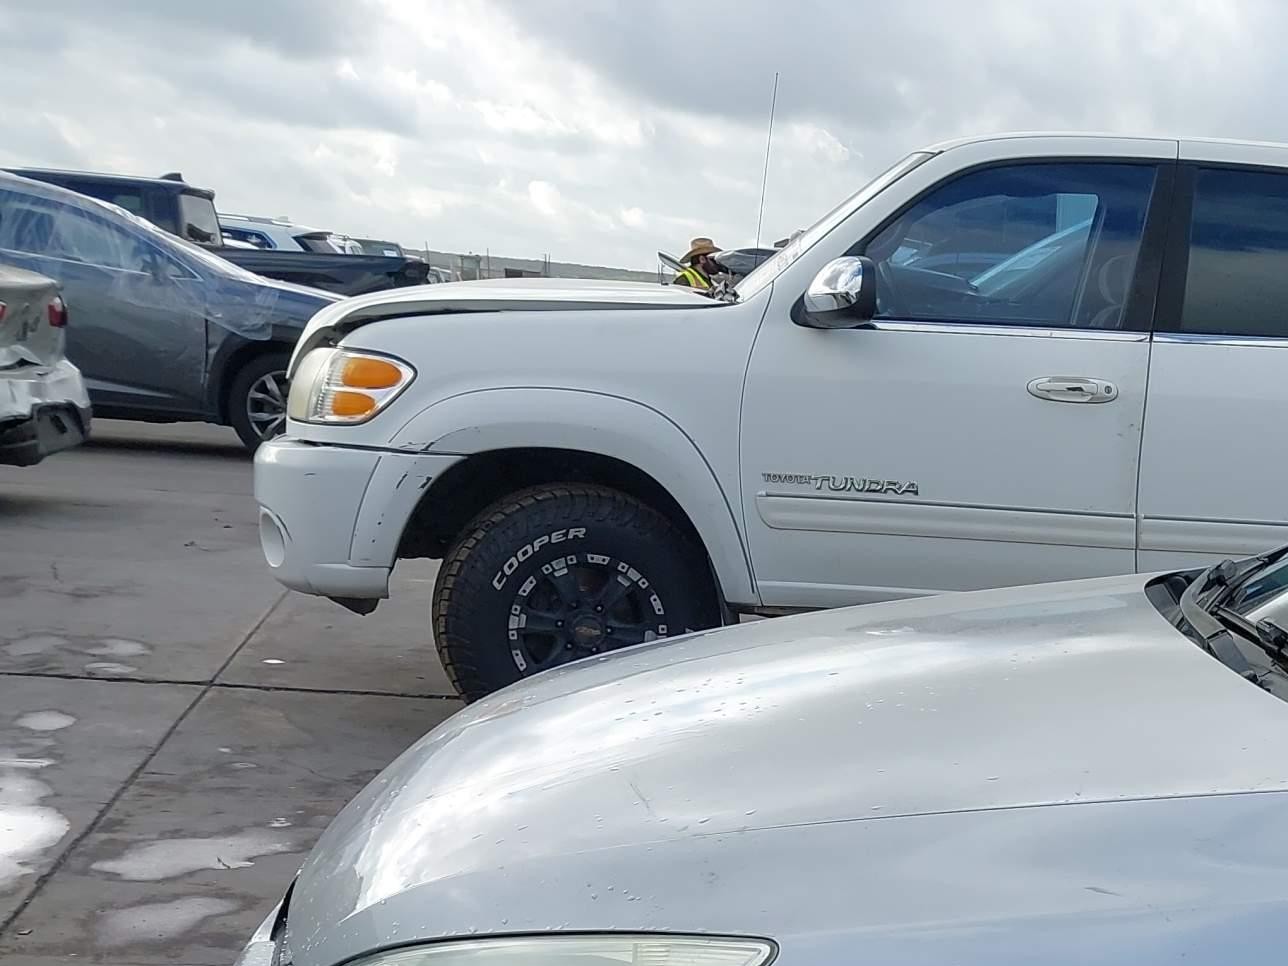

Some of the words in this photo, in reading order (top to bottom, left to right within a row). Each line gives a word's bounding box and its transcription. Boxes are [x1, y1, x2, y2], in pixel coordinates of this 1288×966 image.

[762, 473, 811, 485] TOYOTA
[811, 475, 919, 496] TUNDRA
[492, 528, 586, 591] COOPER
